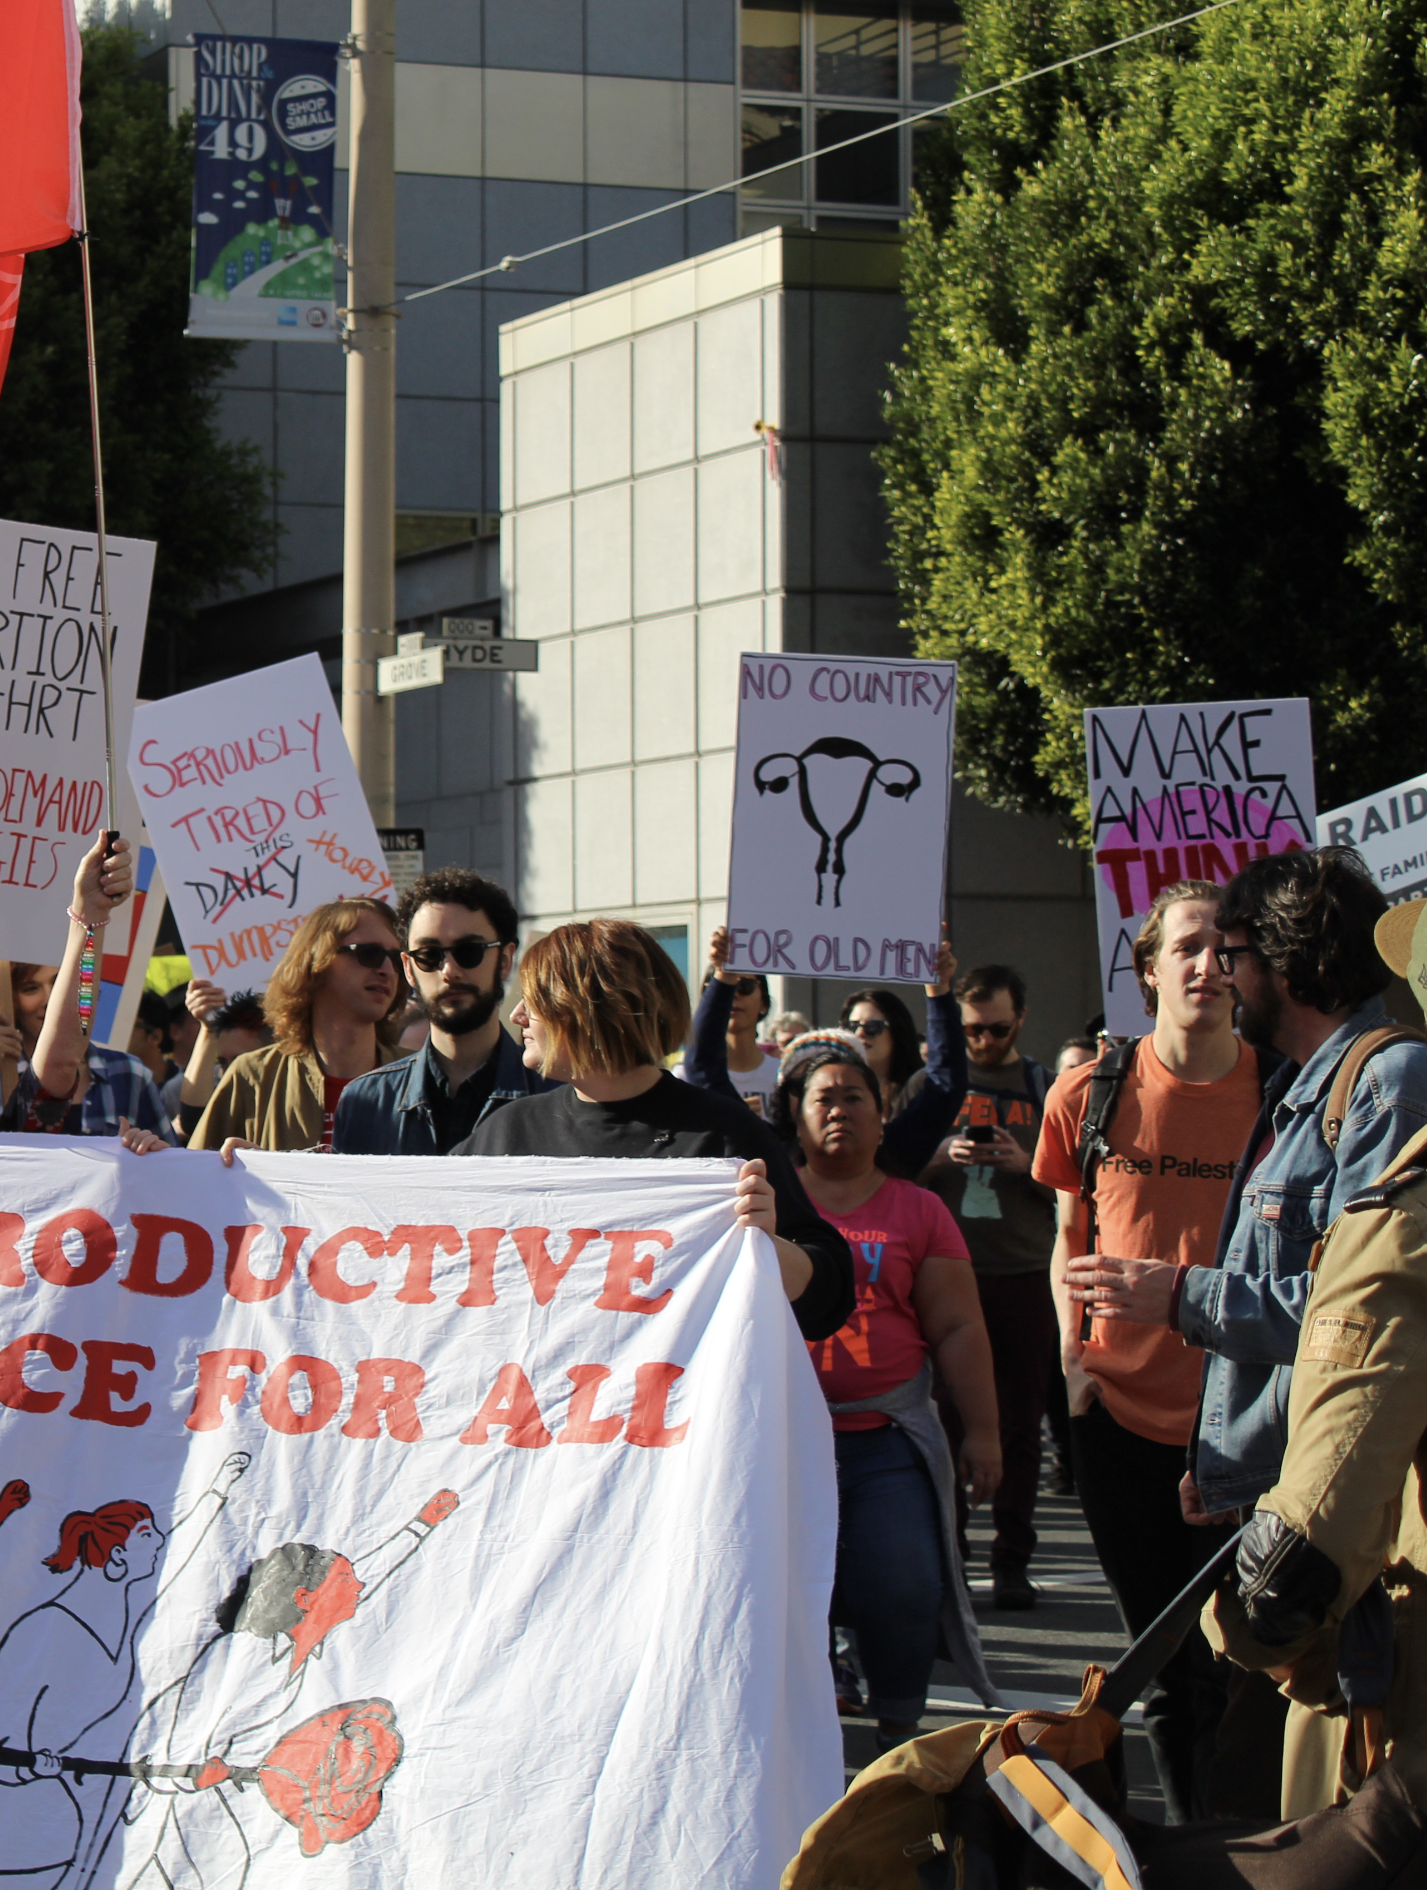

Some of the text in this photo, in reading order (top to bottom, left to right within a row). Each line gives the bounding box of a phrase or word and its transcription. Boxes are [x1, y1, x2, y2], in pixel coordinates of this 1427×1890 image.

[200, 40, 268, 78] SHOP
[200, 77, 265, 120] DINE
[285, 110, 335, 130] SMALL
[286, 97, 328, 116] SHOP
[198, 119, 268, 162] 49
[13, 537, 123, 615] FREE
[741, 663, 955, 715] NO COUNTRY
[139, 713, 321, 798] SERIOUSLY
[1091, 708, 1287, 783] MAKE
[170, 777, 339, 852] TIRED OF
[1092, 781, 1313, 844] AMERICA
[244, 833, 294, 858] THIS
[306, 829, 393, 898] HOURLY
[379, 834, 418, 850] NING
[1379, 850, 1427, 882] FAMI
[183, 855, 301, 920] DAILY
[729, 928, 938, 978] FOR OLD MEN
[1102, 1155, 1240, 1180] Free Palest
[184, 1347, 425, 1443] FOR
[459, 1362, 690, 1449] ALL
